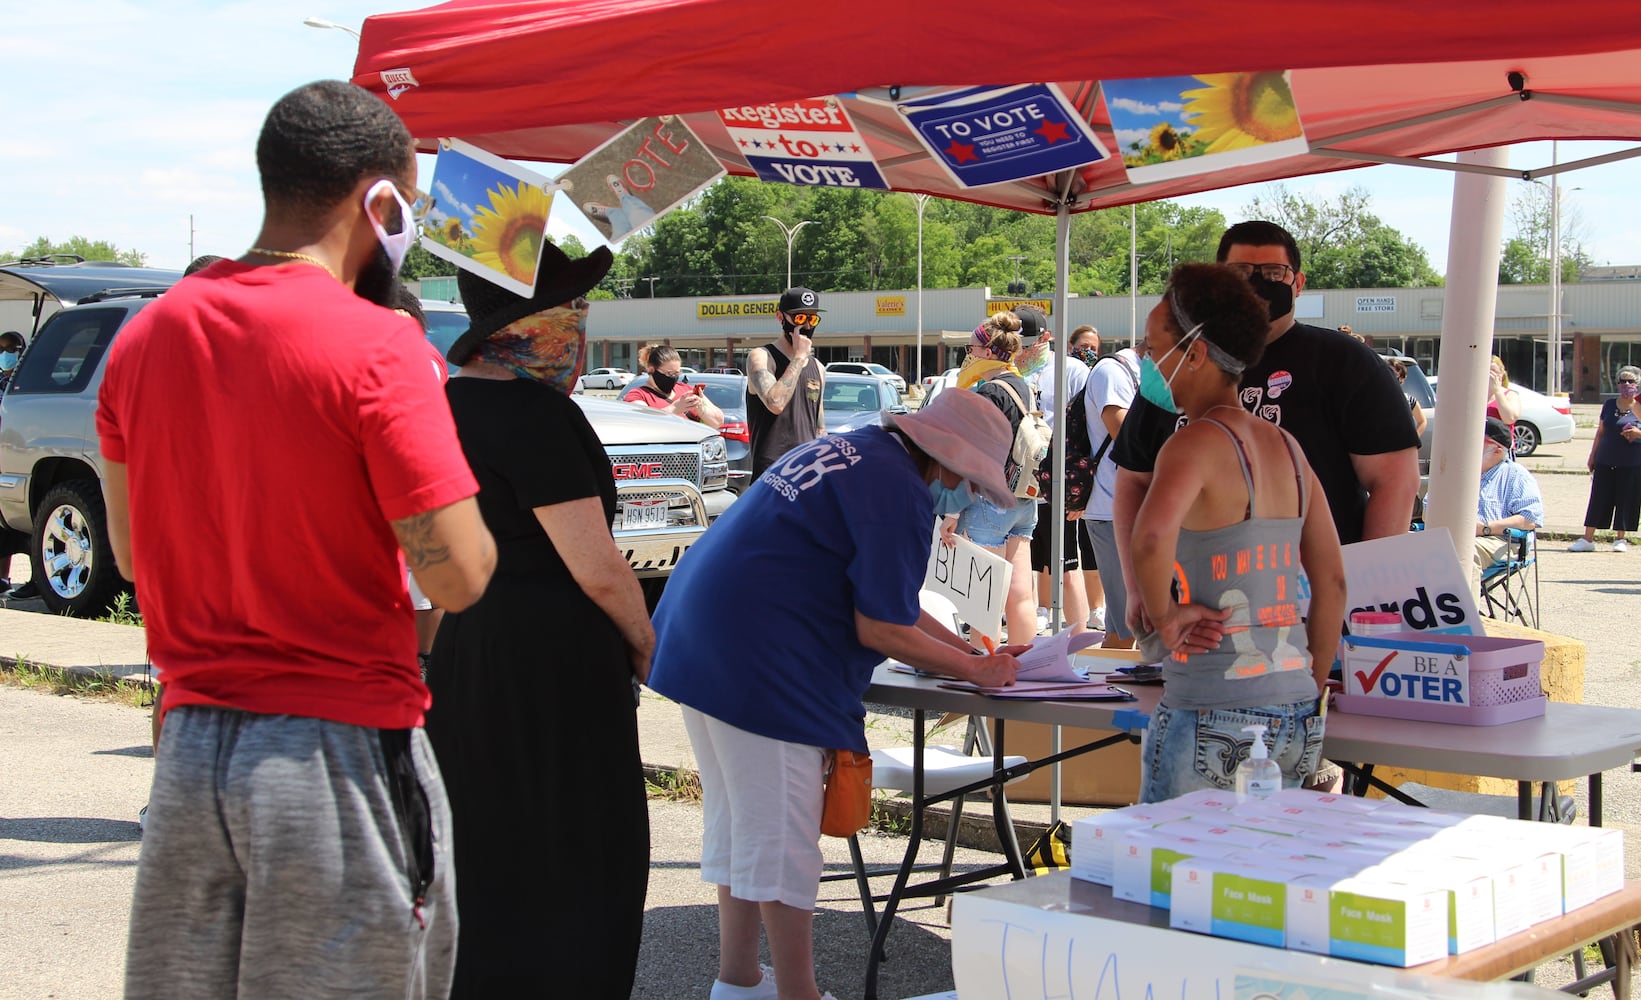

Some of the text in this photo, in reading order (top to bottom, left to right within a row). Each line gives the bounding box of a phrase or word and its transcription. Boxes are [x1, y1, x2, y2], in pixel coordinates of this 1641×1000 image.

[384, 72, 410, 83] QUEST
[935, 103, 1045, 138] TO VOTE
[778, 134, 819, 158] to
[979, 131, 1027, 147] YOU NEED TO
[982, 137, 1035, 153] REGISTER FIRST
[771, 162, 861, 187] VOTE
[701, 303, 740, 315] DOLLAR
[612, 463, 662, 479] GMC
[626, 506, 666, 523] HSN 9513
[935, 538, 992, 612] BLM
[1211, 553, 1228, 581] YOU
[1414, 655, 1459, 676] BE A
[1223, 887, 1273, 905] Face Mask
[1340, 906, 1393, 923] Face Mask
